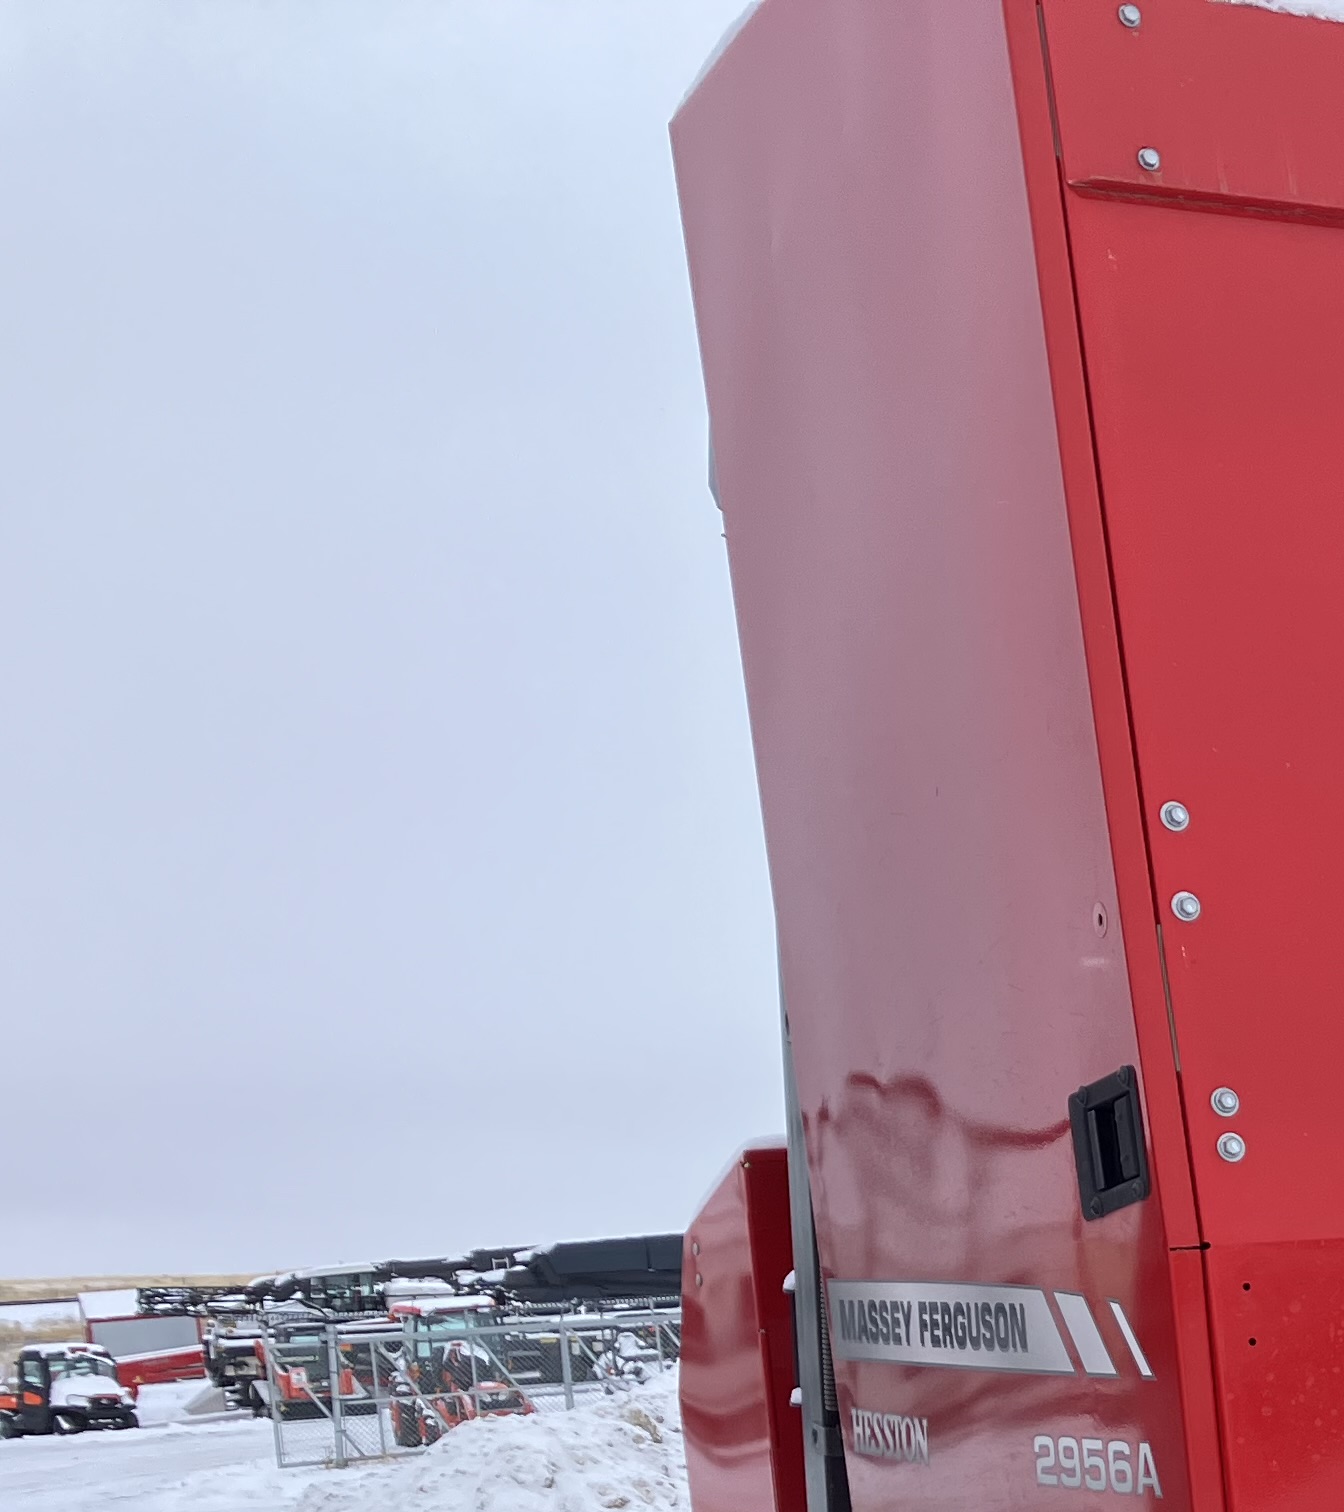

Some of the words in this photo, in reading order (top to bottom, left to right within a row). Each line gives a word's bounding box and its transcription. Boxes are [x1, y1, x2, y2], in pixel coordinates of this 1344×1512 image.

[839, 1299, 913, 1346] MASSEY
[919, 1300, 1029, 1353] FERGUSON
[850, 1407, 930, 1465] HESSTON
[1033, 1434, 1163, 1499] 2956A
